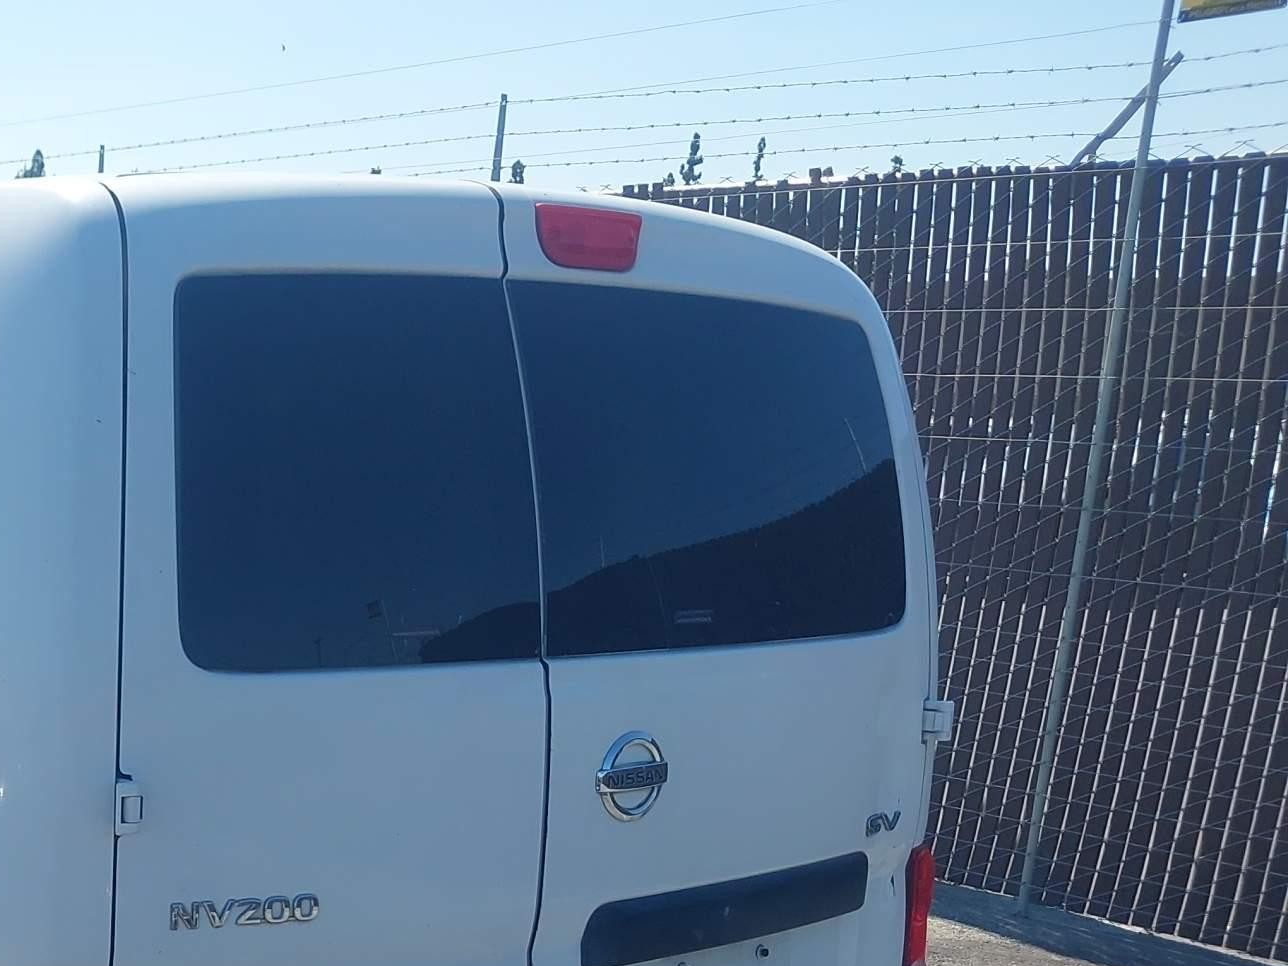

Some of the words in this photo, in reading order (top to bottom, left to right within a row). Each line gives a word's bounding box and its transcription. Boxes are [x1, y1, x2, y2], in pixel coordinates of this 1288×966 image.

[607, 766, 665, 787] NISSAN
[865, 810, 902, 838] SV
[168, 893, 320, 931] NV200
